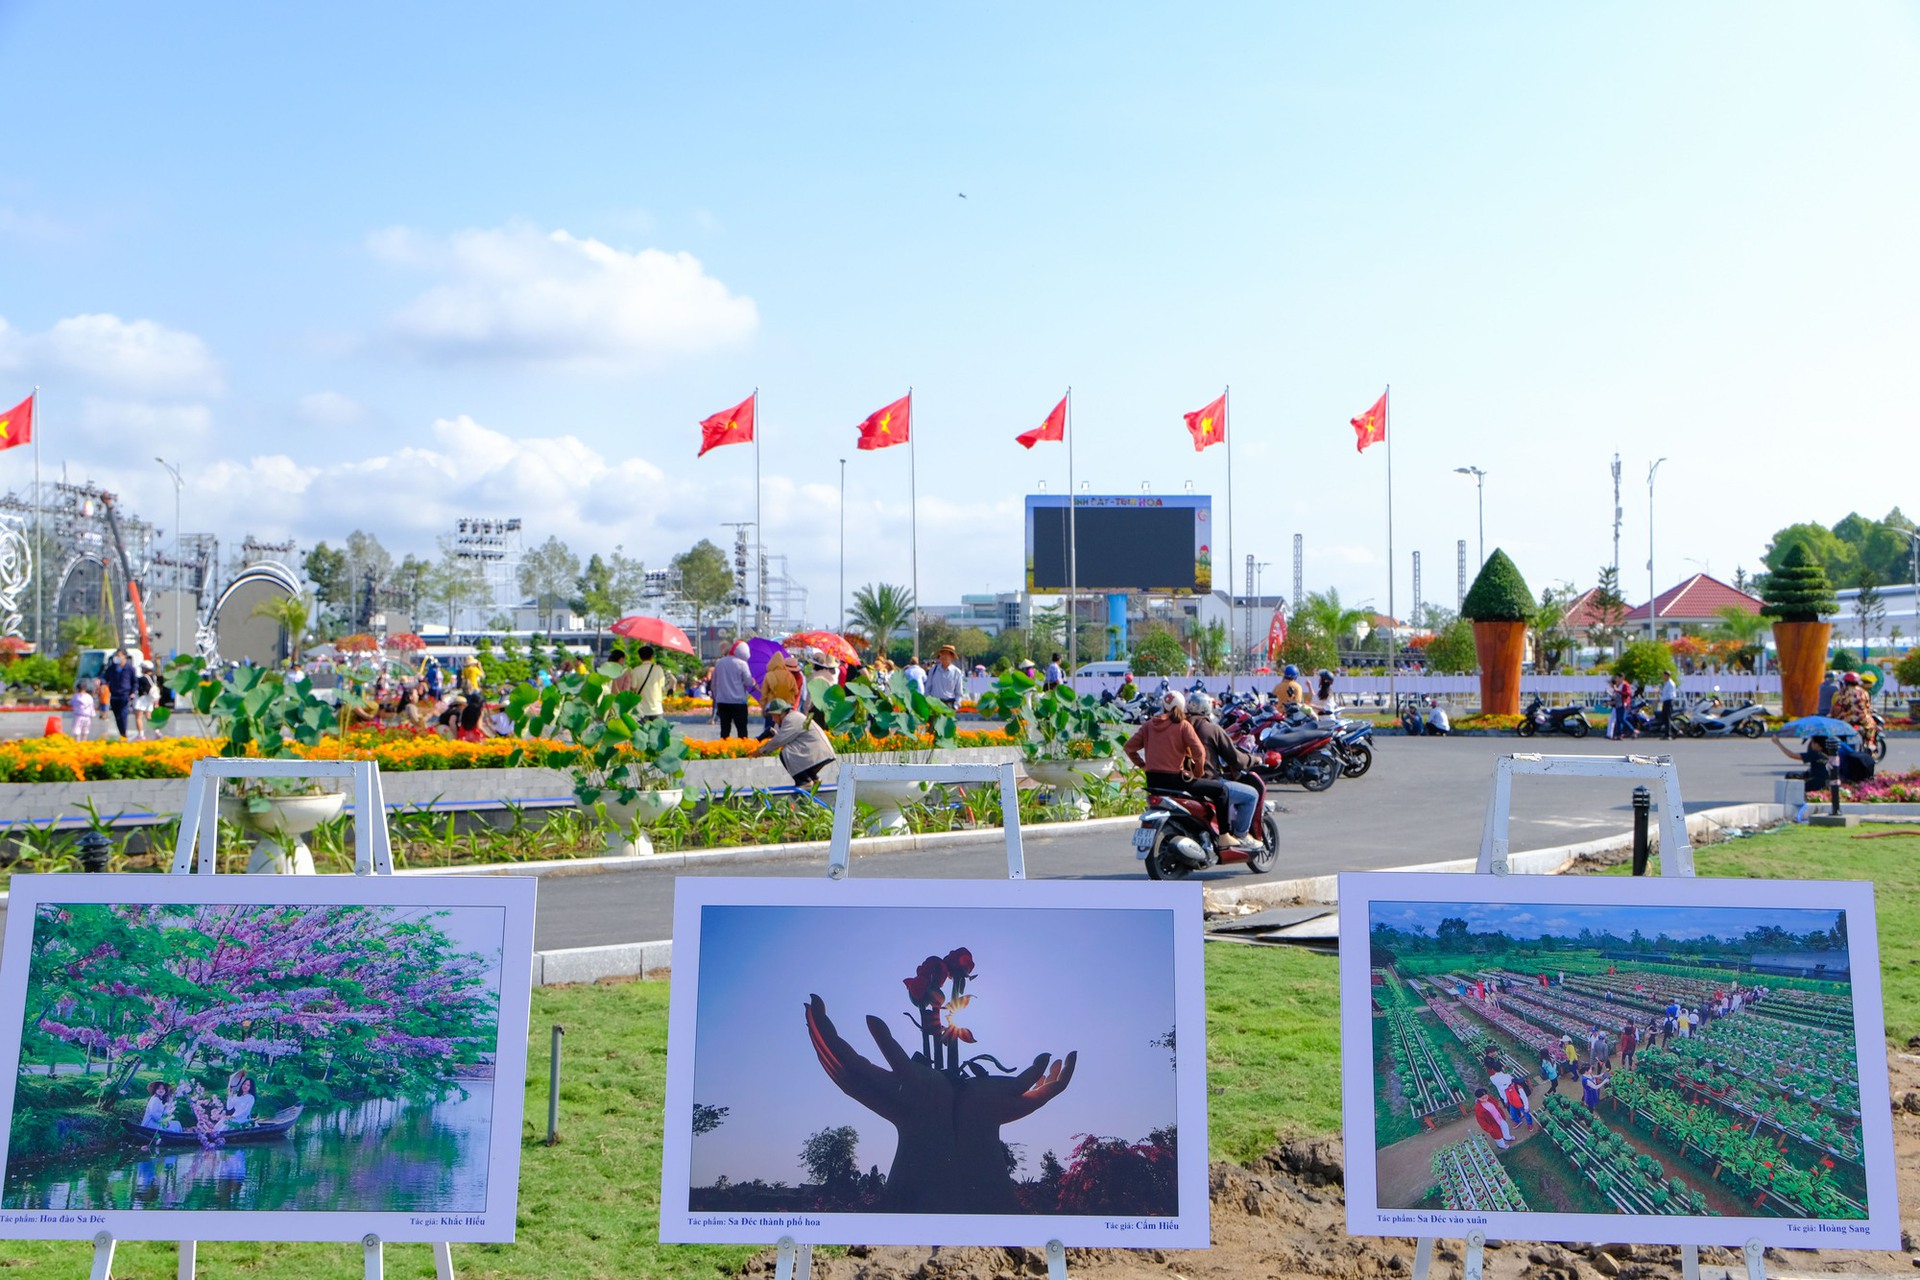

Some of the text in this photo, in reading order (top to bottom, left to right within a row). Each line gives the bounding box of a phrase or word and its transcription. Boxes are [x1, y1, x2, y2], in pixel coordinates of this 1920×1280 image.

[1138, 497, 1163, 507] HOA
[40, 1215, 57, 1223] Hoa
[59, 1215, 74, 1223] đào
[77, 1215, 87, 1223] Sa
[90, 1215, 106, 1223] Đéc
[410, 1217, 423, 1225] Tác
[441, 1215, 463, 1225] Khắc
[466, 1215, 486, 1225] Hiếu
[688, 1217, 701, 1225] Tác
[728, 1217, 739, 1225] Sa
[741, 1217, 757, 1226] Đéc
[759, 1217, 784, 1226] thành
[786, 1215, 802, 1227] phố
[805, 1218, 821, 1226] hoa
[1377, 1214, 1390, 1222] Tác
[1417, 1215, 1428, 1223] Sa
[1430, 1214, 1446, 1223] Đéc
[1449, 1215, 1464, 1224] vào
[1466, 1215, 1487, 1224] xuân
[1159, 1220, 1179, 1230] Hiếu
[1788, 1224, 1801, 1232] Tác
[1818, 1223, 1847, 1234] Hoàng
[1849, 1225, 1870, 1234] Sang
